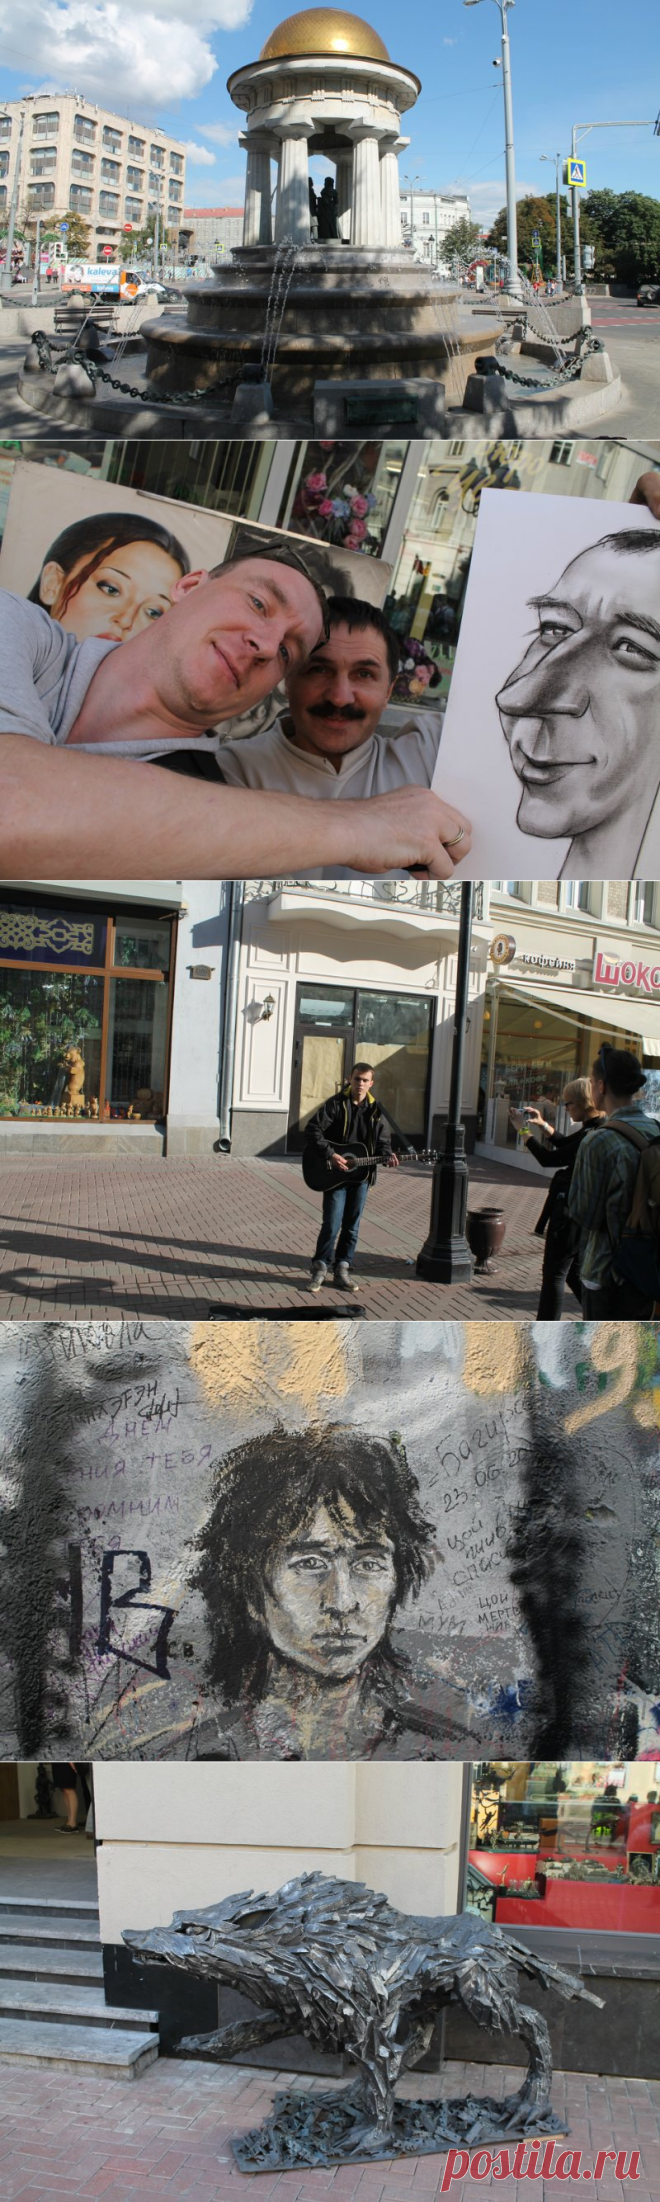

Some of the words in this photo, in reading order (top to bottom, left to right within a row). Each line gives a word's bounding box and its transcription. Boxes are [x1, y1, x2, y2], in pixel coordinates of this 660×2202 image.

[87, 267, 117, 276] kaleva
[522, 954, 576, 971] кофейня
[146, 1445, 212, 1470] ТЕБЯ
